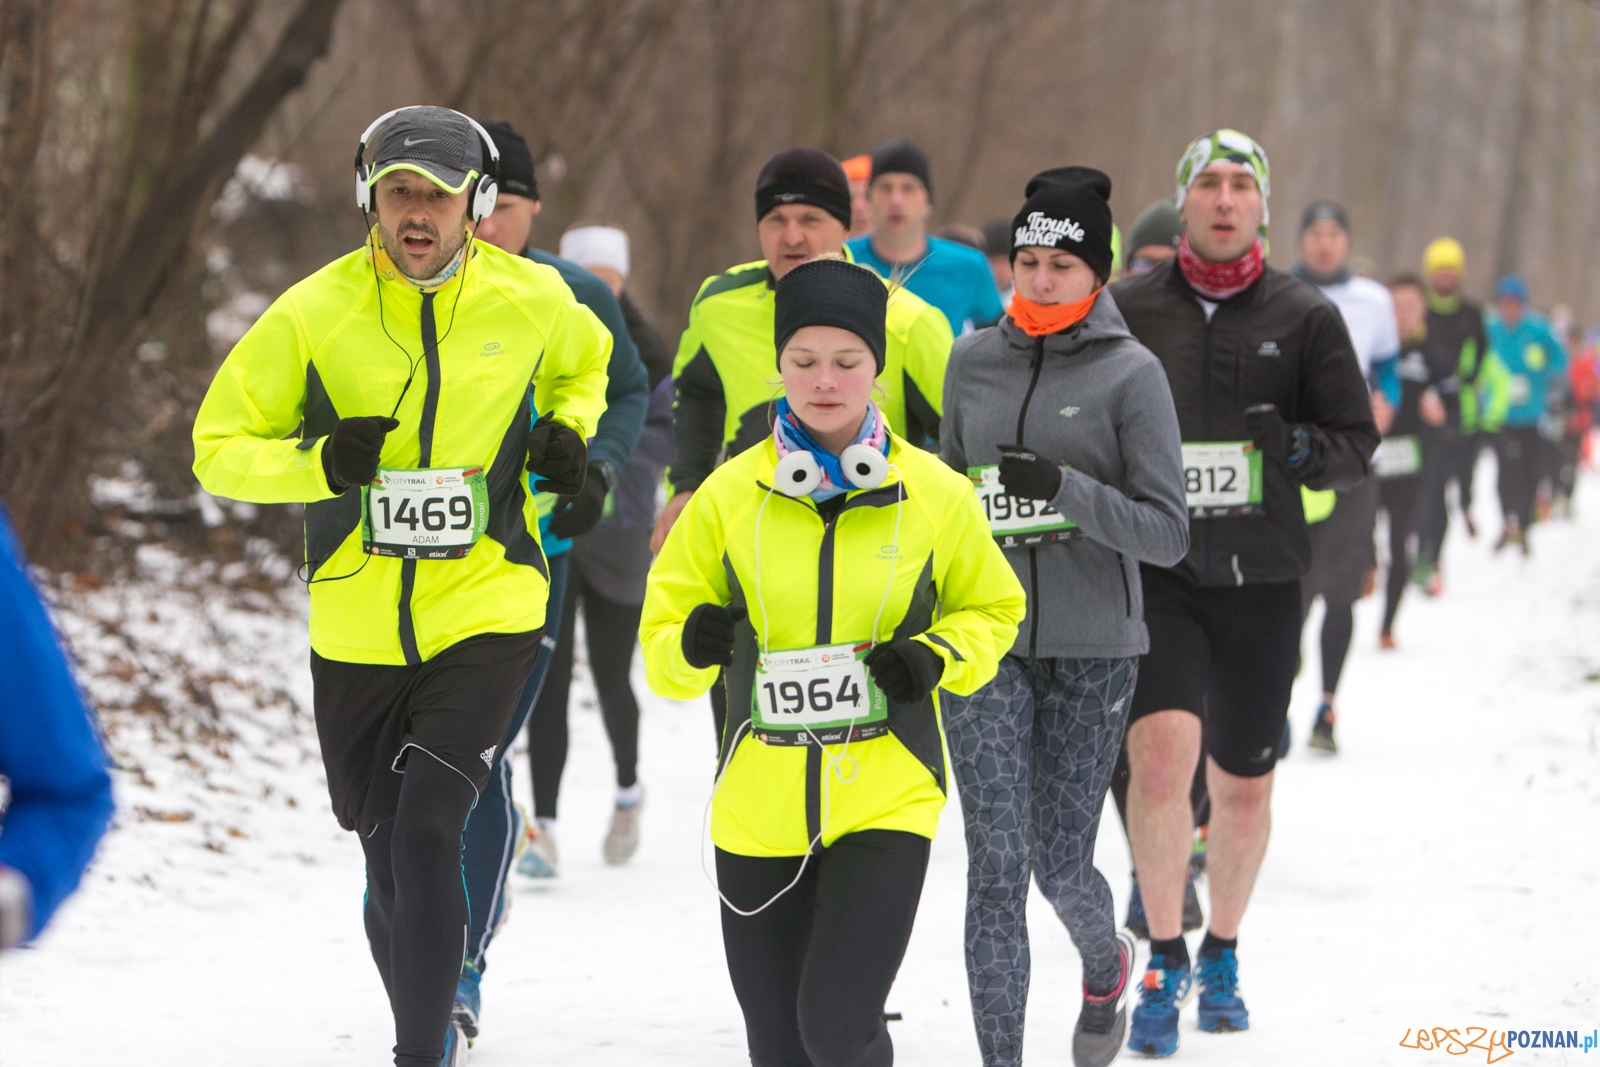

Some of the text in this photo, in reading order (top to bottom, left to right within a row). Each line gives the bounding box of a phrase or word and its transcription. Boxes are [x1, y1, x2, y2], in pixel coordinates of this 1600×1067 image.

[1014, 225, 1063, 248] Maker
[1027, 211, 1085, 242] Trouble
[377, 495, 472, 532] 1469
[412, 535, 440, 544] ADAM
[763, 675, 861, 714] 1964
